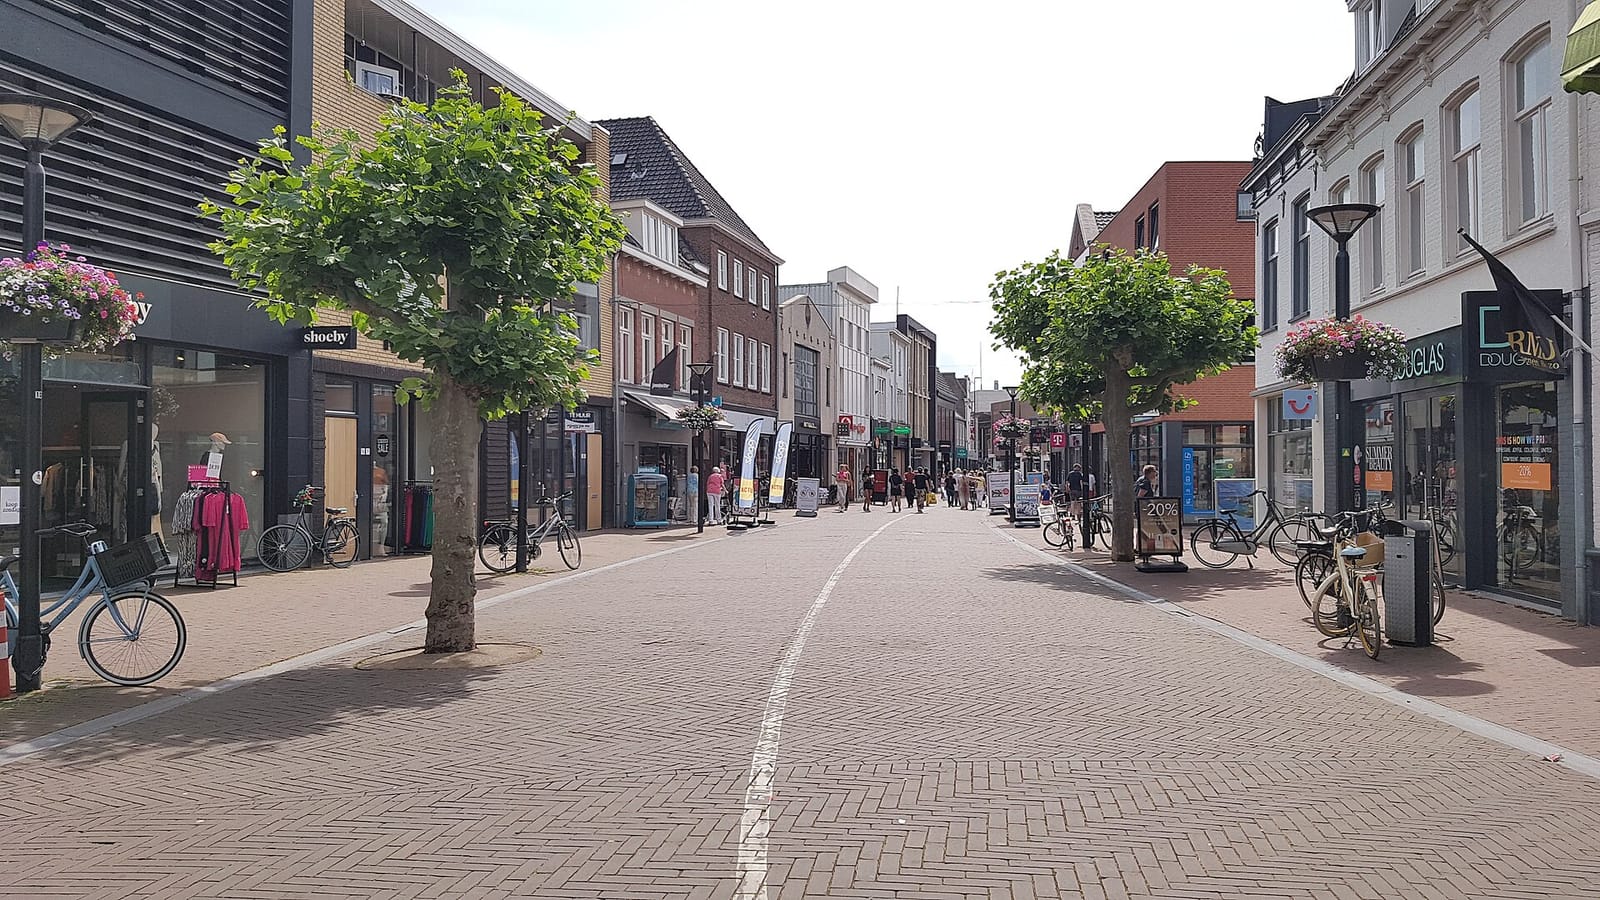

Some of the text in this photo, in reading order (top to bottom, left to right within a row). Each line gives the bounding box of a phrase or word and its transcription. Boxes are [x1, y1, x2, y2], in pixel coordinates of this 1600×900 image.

[303, 330, 349, 345] shoeby
[1505, 330, 1556, 361] RMJ
[1393, 342, 1444, 381] OUGLAS
[1480, 353, 1526, 366] DOUG
[1053, 434, 1063, 445] T
[377, 443, 388, 453] SALE
[1365, 446, 1393, 459] SUMMER
[1369, 459, 1392, 471] BEAUTY
[1142, 503, 1178, 516] -20%
